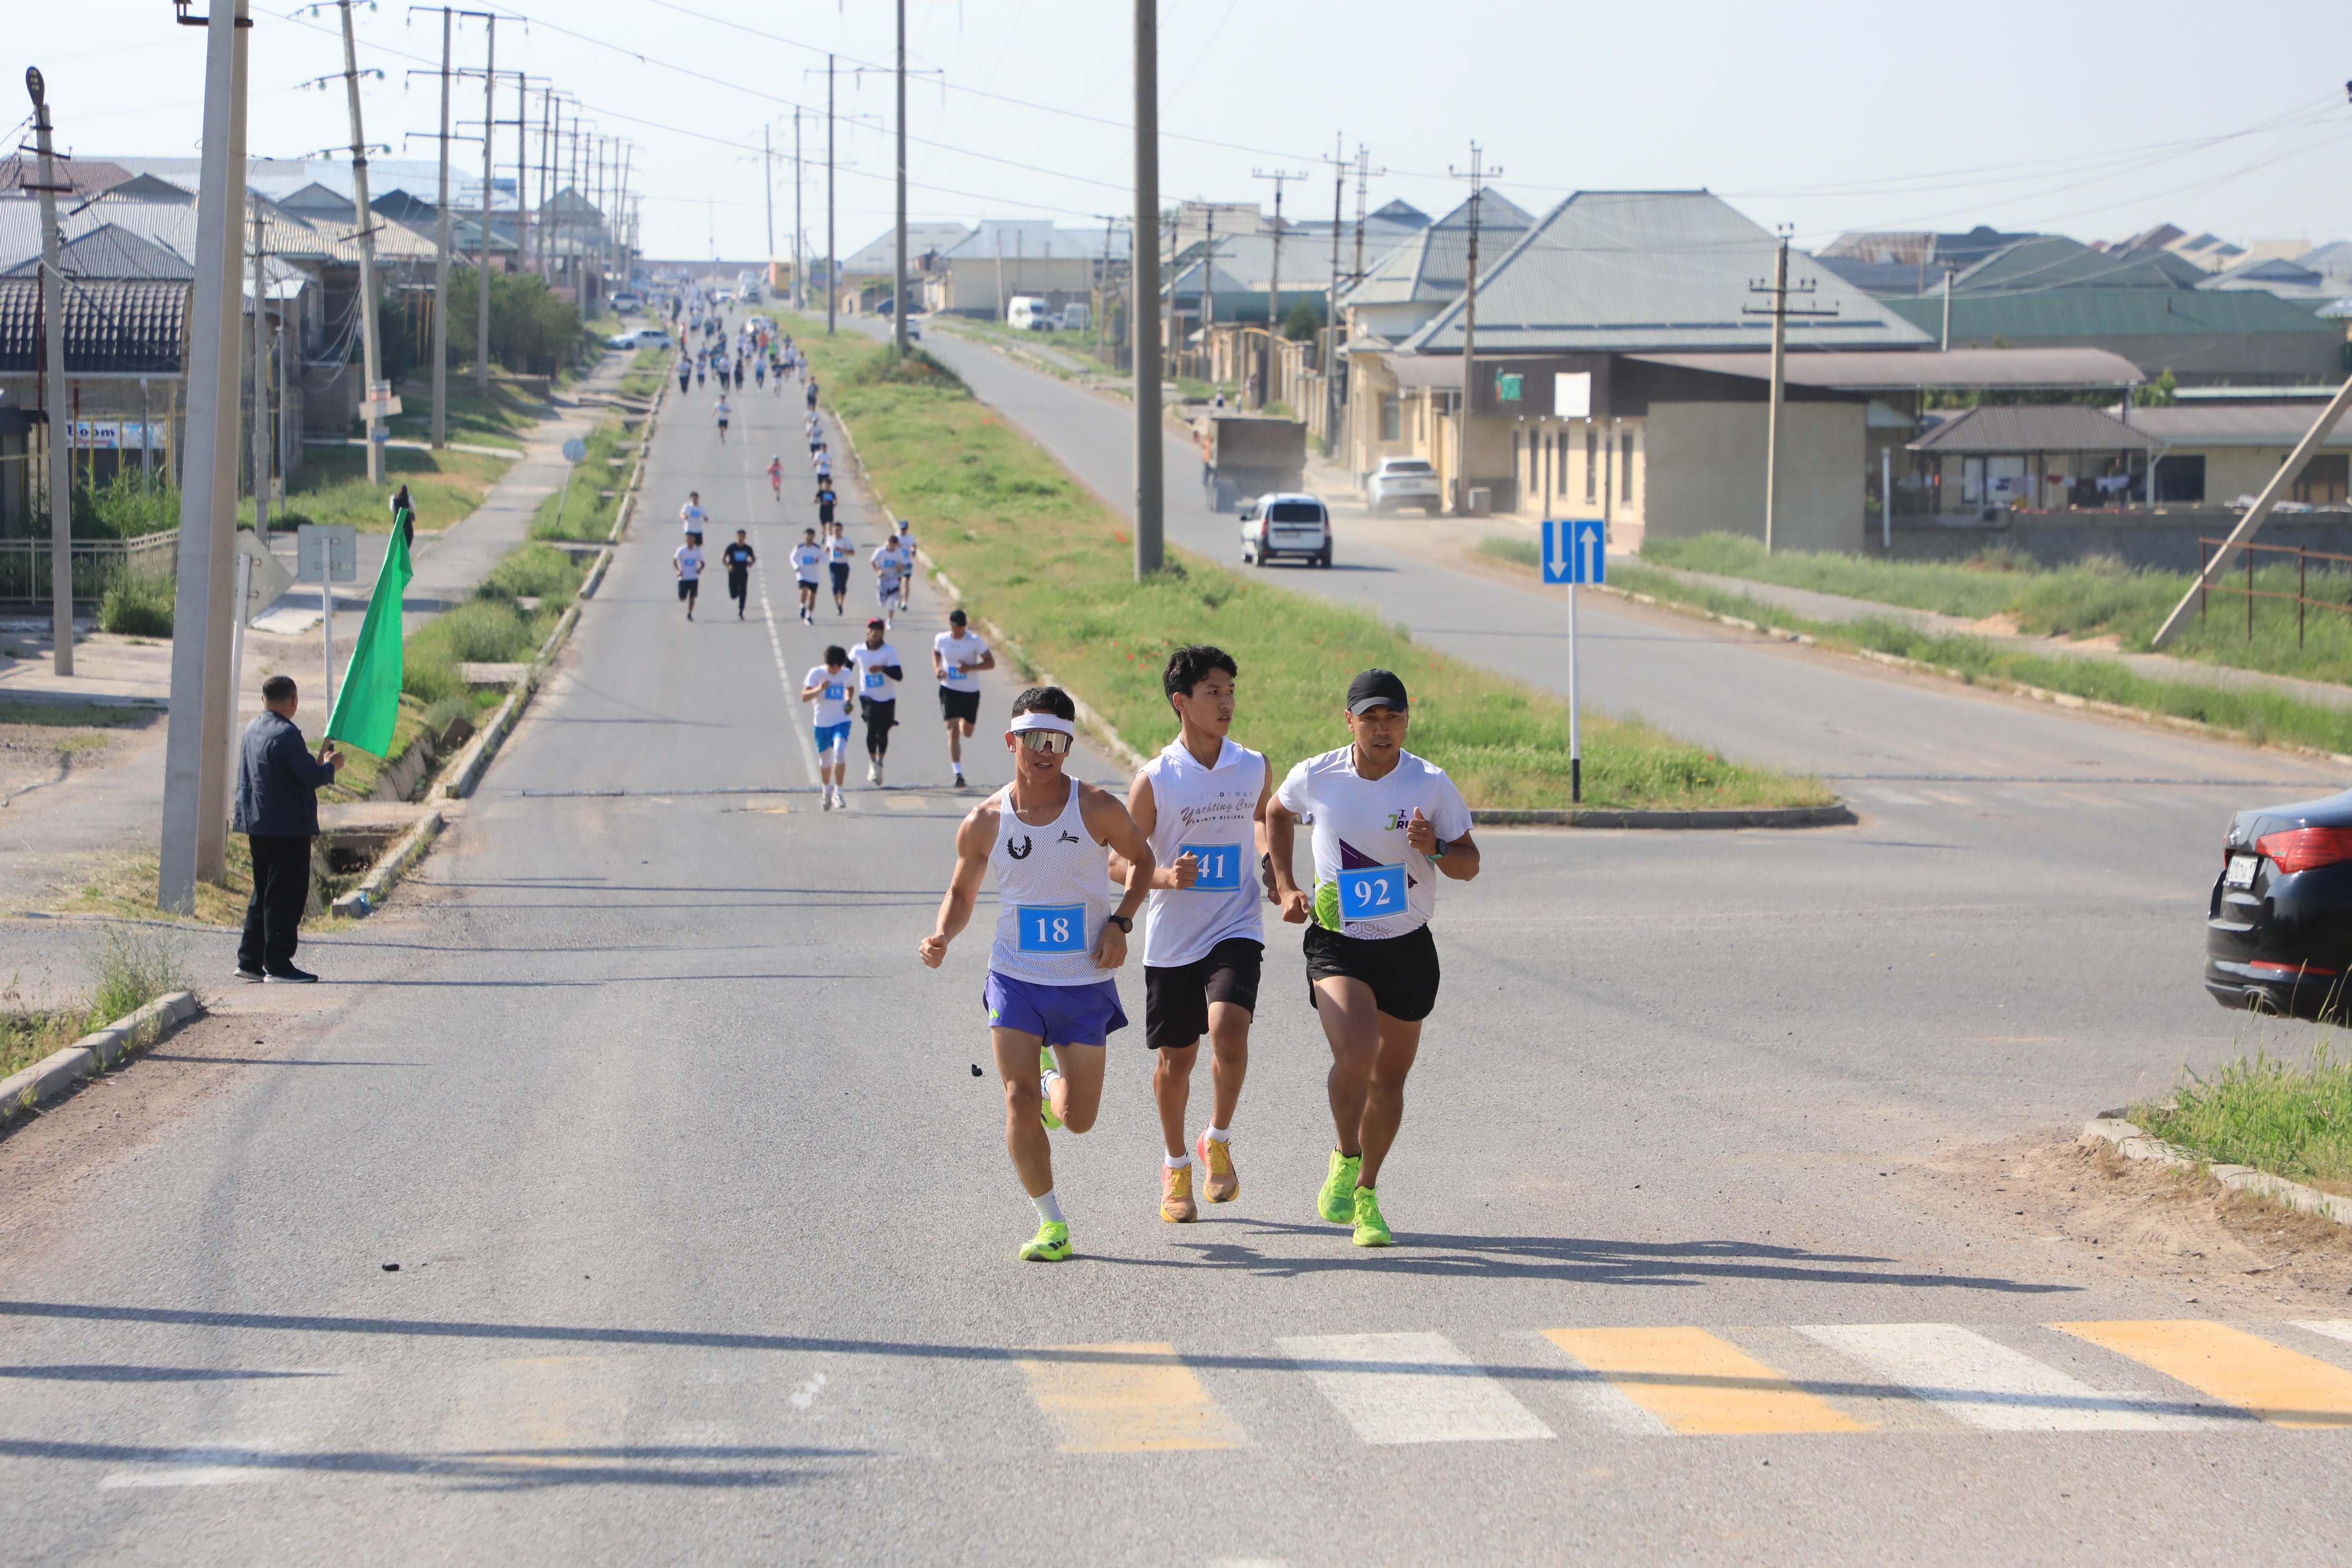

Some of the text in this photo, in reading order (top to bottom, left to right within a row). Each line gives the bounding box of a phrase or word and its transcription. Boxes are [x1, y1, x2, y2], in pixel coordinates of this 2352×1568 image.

[1180, 802, 1232, 827] Yachting
[1192, 815, 1216, 824] FRENCH
[1197, 854, 1225, 878] 41
[1354, 878, 1390, 908] 92
[1036, 918, 1069, 943] 18
